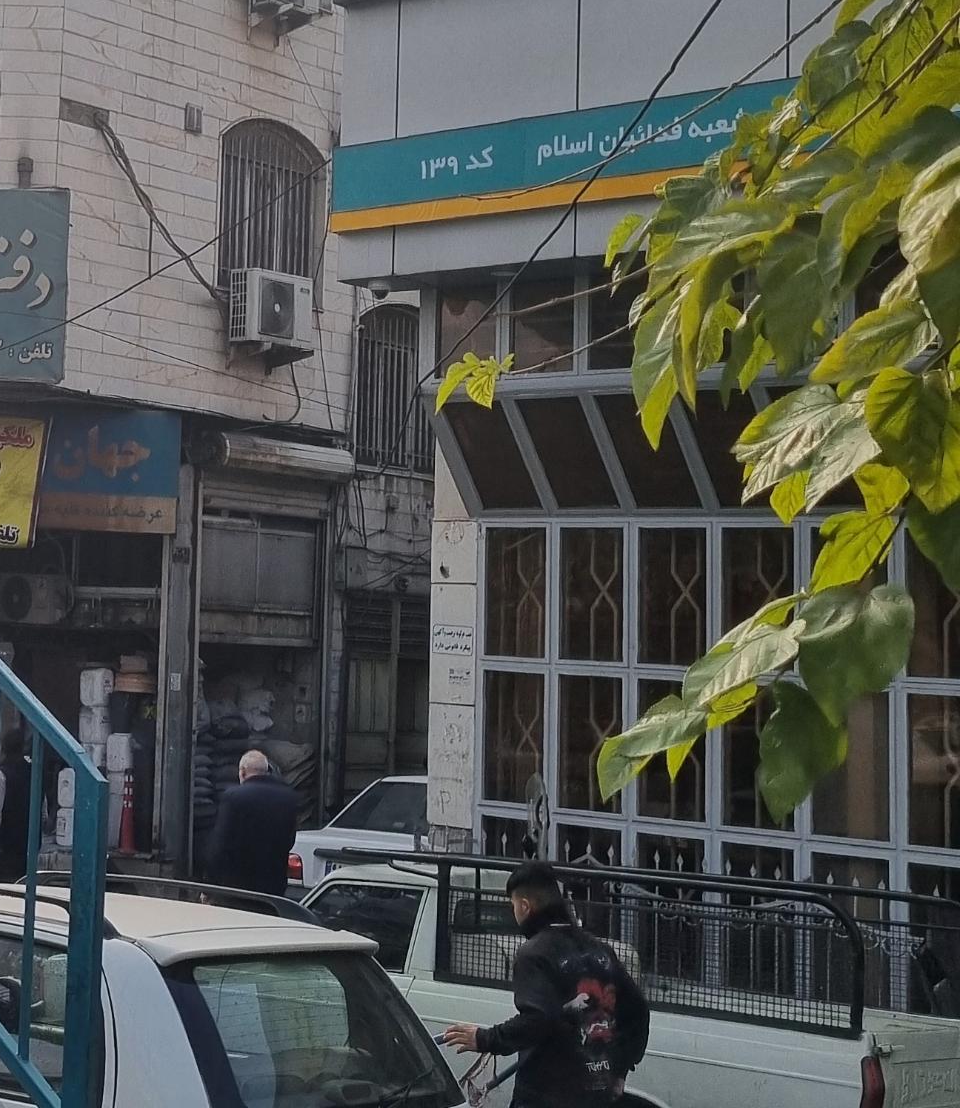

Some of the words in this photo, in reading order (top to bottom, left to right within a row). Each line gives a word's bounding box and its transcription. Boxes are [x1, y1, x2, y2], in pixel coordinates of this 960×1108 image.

[465, 146, 494, 172] کد
[536, 132, 593, 166] اسلام
[420, 156, 459, 180] ۱۳۹
